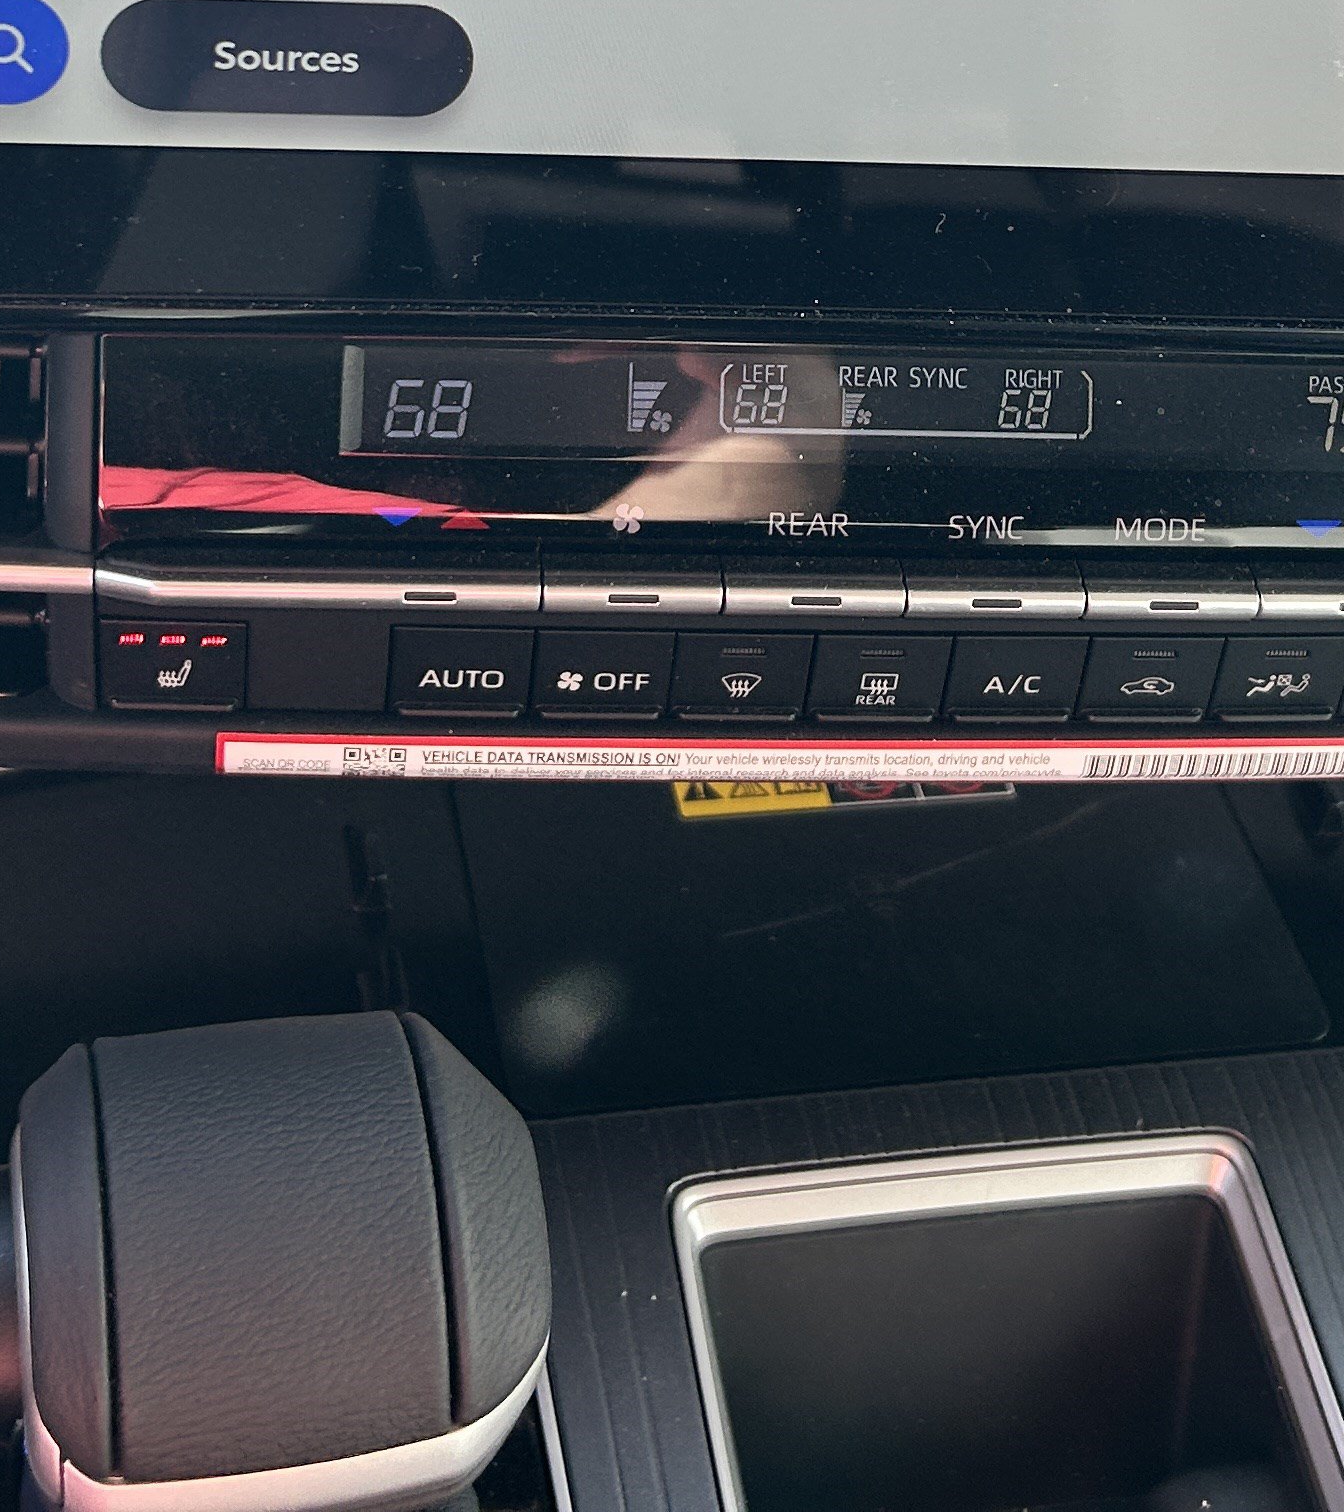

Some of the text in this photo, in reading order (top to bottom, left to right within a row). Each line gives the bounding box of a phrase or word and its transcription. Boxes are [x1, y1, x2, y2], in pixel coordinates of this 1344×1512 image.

[213, 40, 360, 76] Sources
[742, 364, 788, 384] LEFT
[839, 366, 968, 389] REAR SYNC
[1005, 369, 1063, 389] RIGHT
[383, 378, 473, 439] 68
[733, 384, 788, 425] 68
[998, 389, 1052, 429] 68
[767, 512, 849, 537] REAR
[948, 515, 1024, 540] SYNC
[1114, 517, 1206, 542] MODE
[419, 669, 505, 689] AUTO
[593, 672, 651, 692] OFF
[983, 675, 1042, 695] A/C
[856, 694, 896, 706] REAR
[243, 758, 276, 769] SCAN
[298, 759, 331, 770] CODE
[422, 750, 1051, 770] VEHICLE DATA TRANSMISSION IS ON! Your vehicle wirelessly transmits location, driving and vehicle
